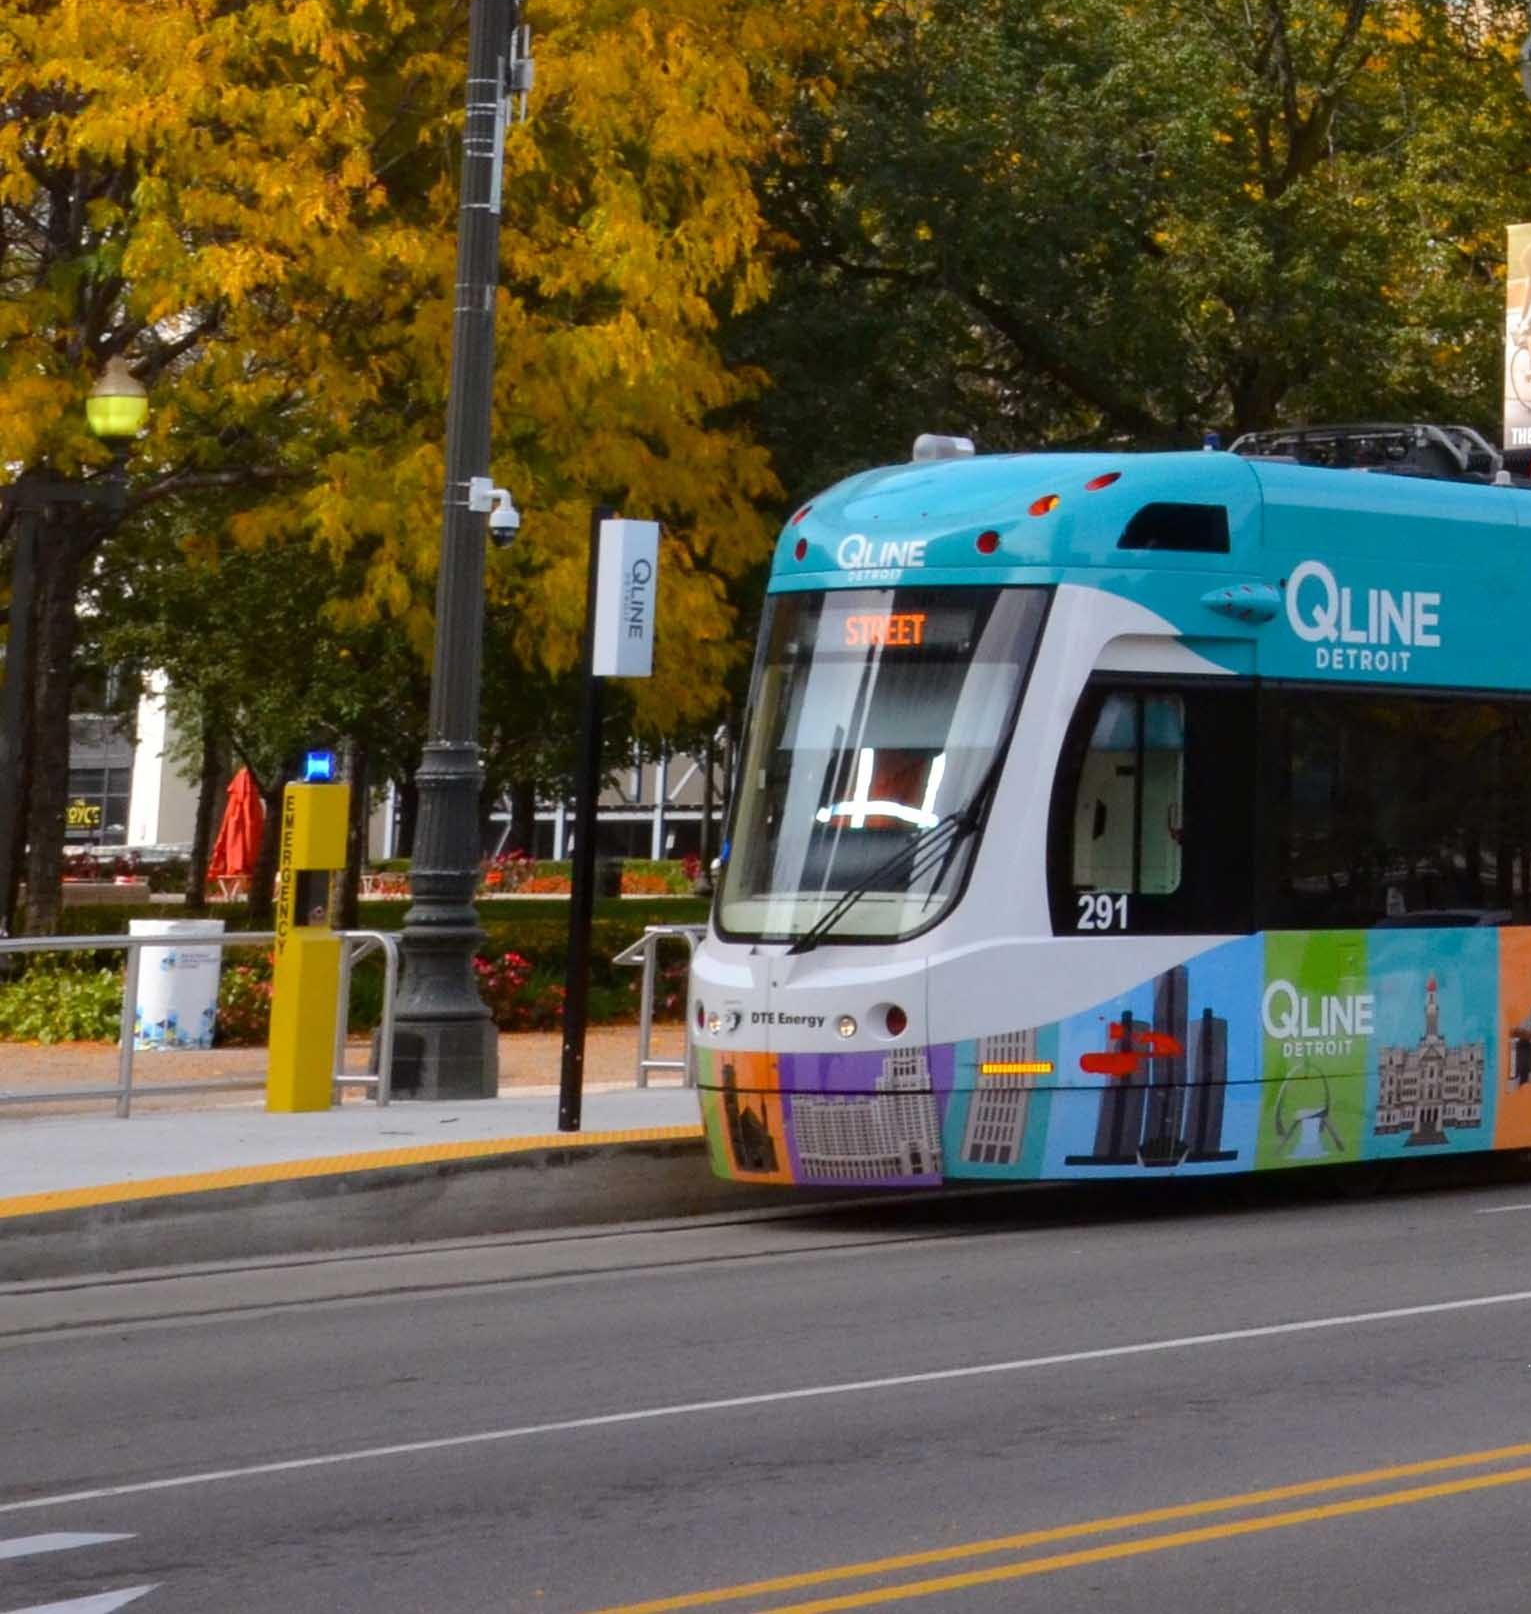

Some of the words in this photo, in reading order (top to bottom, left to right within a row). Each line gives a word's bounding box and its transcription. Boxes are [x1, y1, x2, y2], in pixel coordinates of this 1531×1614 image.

[837, 533, 928, 570] QLINE
[628, 558, 652, 639] QLINE
[1285, 559, 1441, 648] QLINE
[845, 613, 927, 646] STREET
[1315, 647, 1412, 673] DETROIT
[277, 795, 296, 955] EMERGENCY
[1076, 893, 1128, 930] 291
[751, 1012, 776, 1025] DTE
[778, 1011, 825, 1029] Energy
[1261, 978, 1376, 1039] QLINE
[1283, 1040, 1353, 1058] DETROIT
